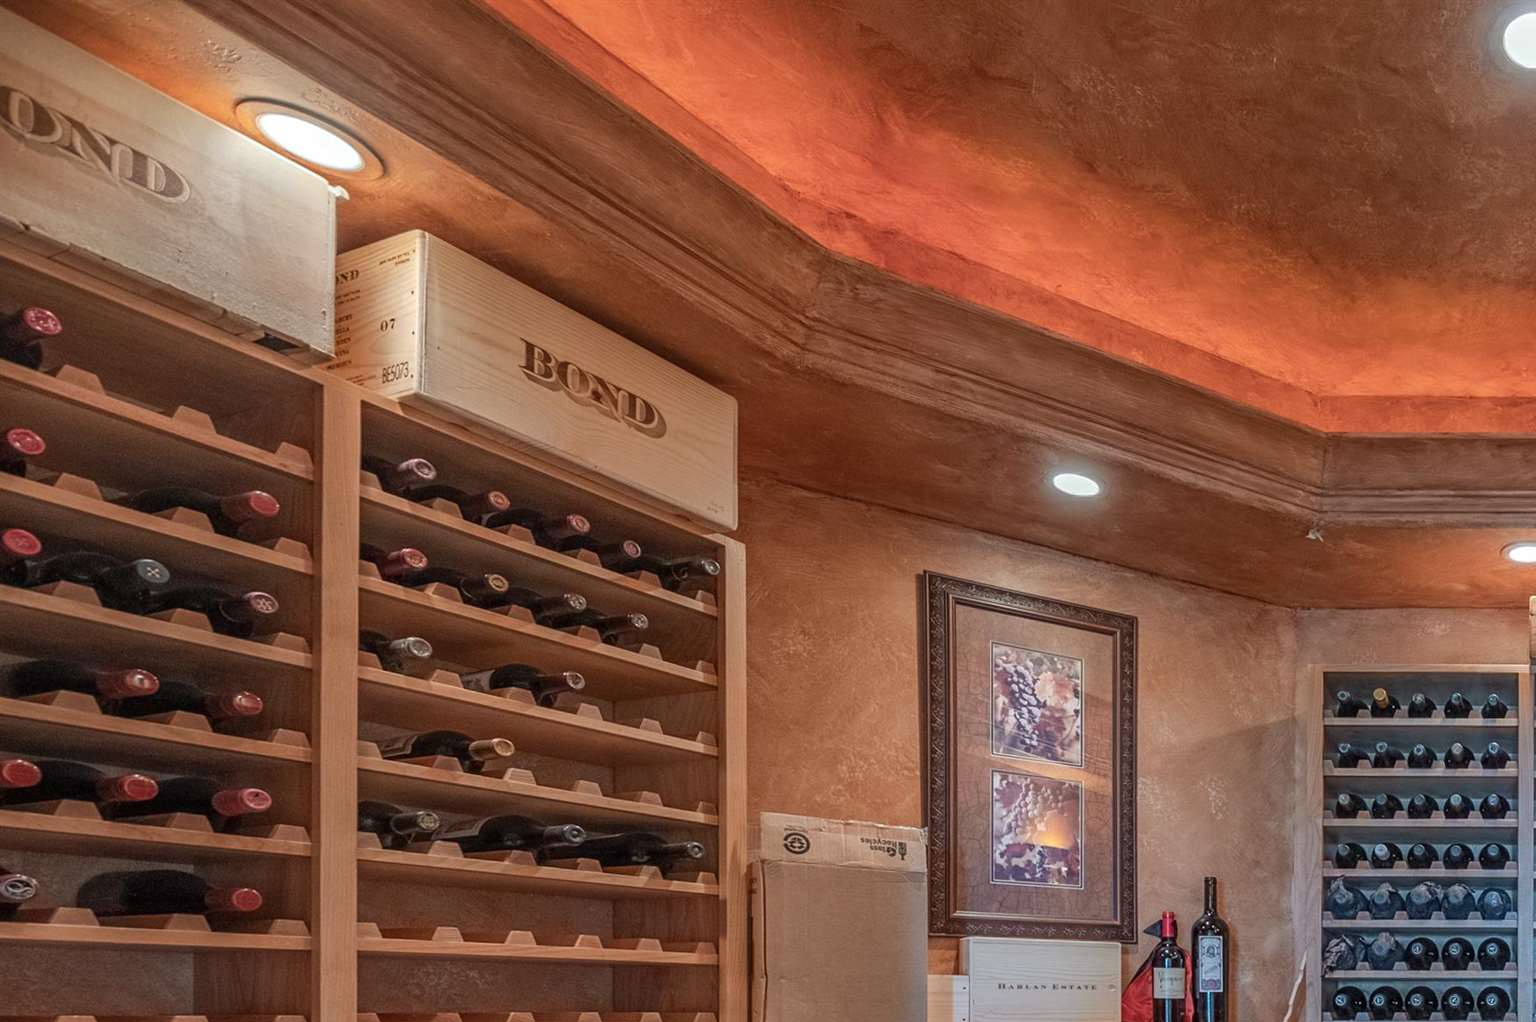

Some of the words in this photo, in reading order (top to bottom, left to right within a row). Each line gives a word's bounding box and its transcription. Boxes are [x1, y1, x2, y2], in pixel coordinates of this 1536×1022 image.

[0, 86, 191, 203] OND
[380, 319, 396, 332] 07
[519, 337, 667, 438] BOND
